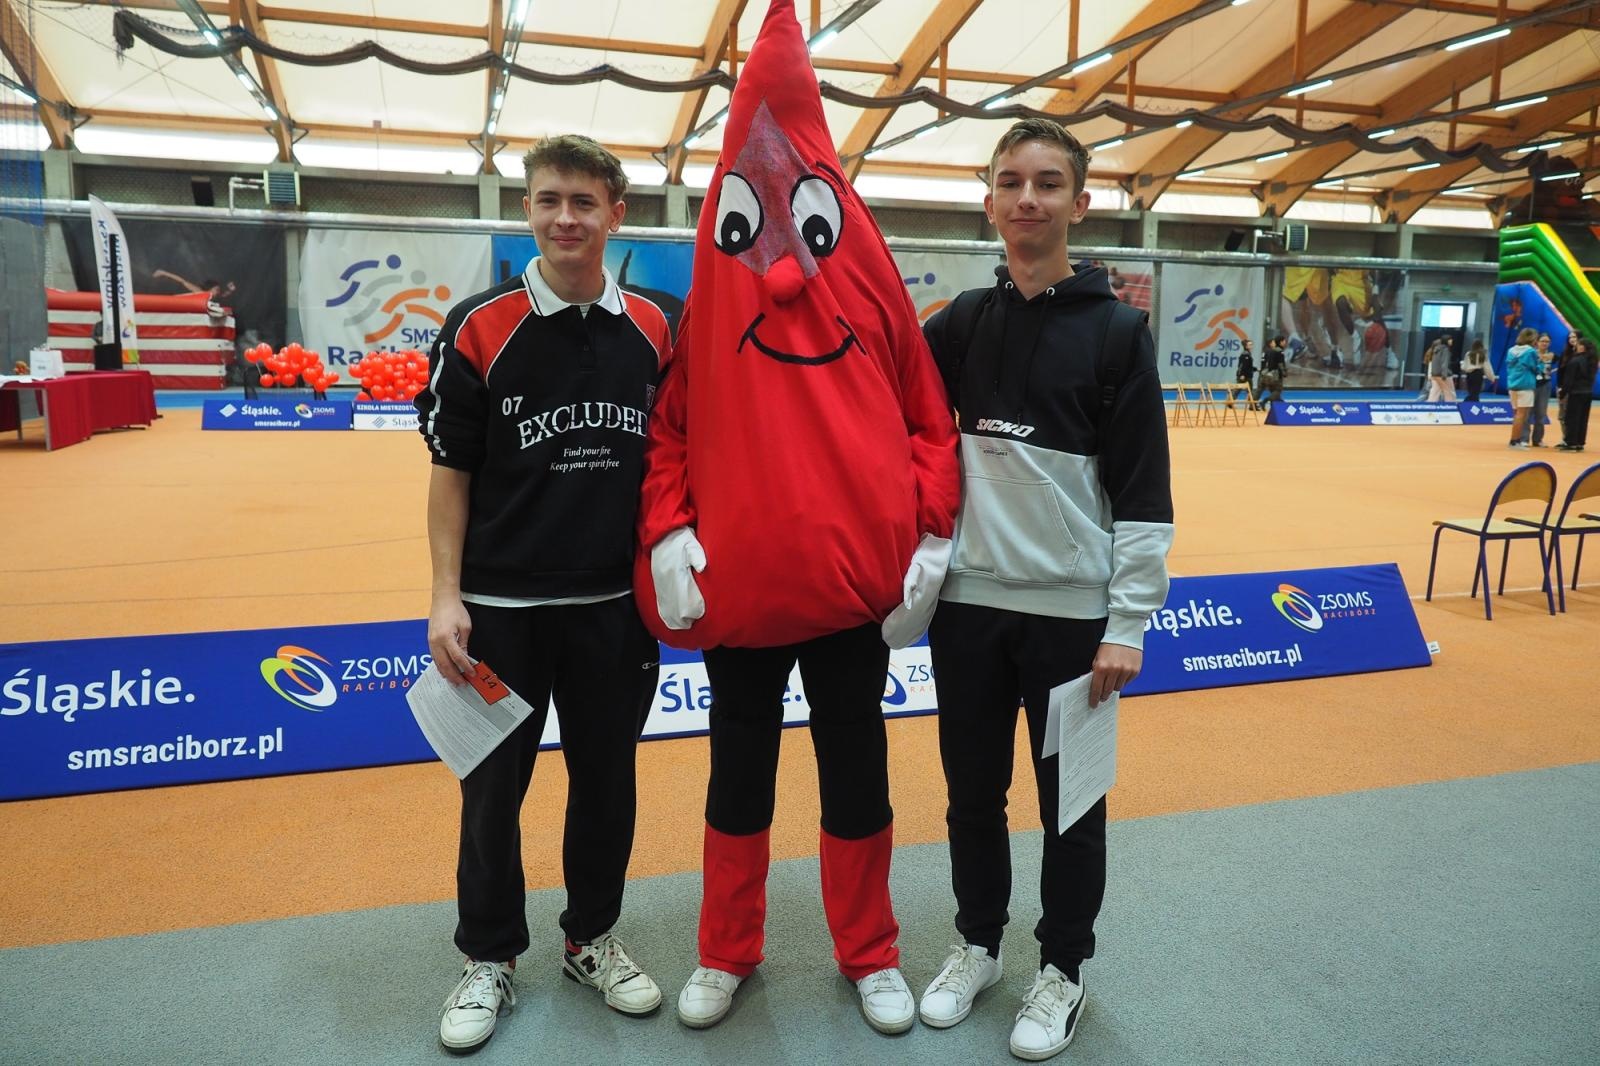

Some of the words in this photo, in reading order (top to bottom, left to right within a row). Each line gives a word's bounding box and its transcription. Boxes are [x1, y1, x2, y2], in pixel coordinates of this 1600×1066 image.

[1218, 338, 1240, 351] SMS
[1170, 351, 1237, 368] Racibór
[502, 396, 523, 416] 07
[392, 415, 418, 427] Śląsk
[517, 402, 648, 449] EXCLUDED
[976, 418, 1035, 438] SICKO
[563, 446, 582, 457] Find
[581, 448, 600, 458] your
[550, 462, 569, 473] Keep
[568, 461, 588, 472] your
[604, 458, 620, 471] free
[1317, 591, 1373, 610] ZSOMS
[1144, 598, 1242, 637] ląskie.
[1183, 643, 1303, 672] smsraciborz.pl
[342, 677, 410, 693] RACIBÓ
[0, 668, 196, 722] Śląskie.
[67, 727, 283, 770] smsraciborz.pl
